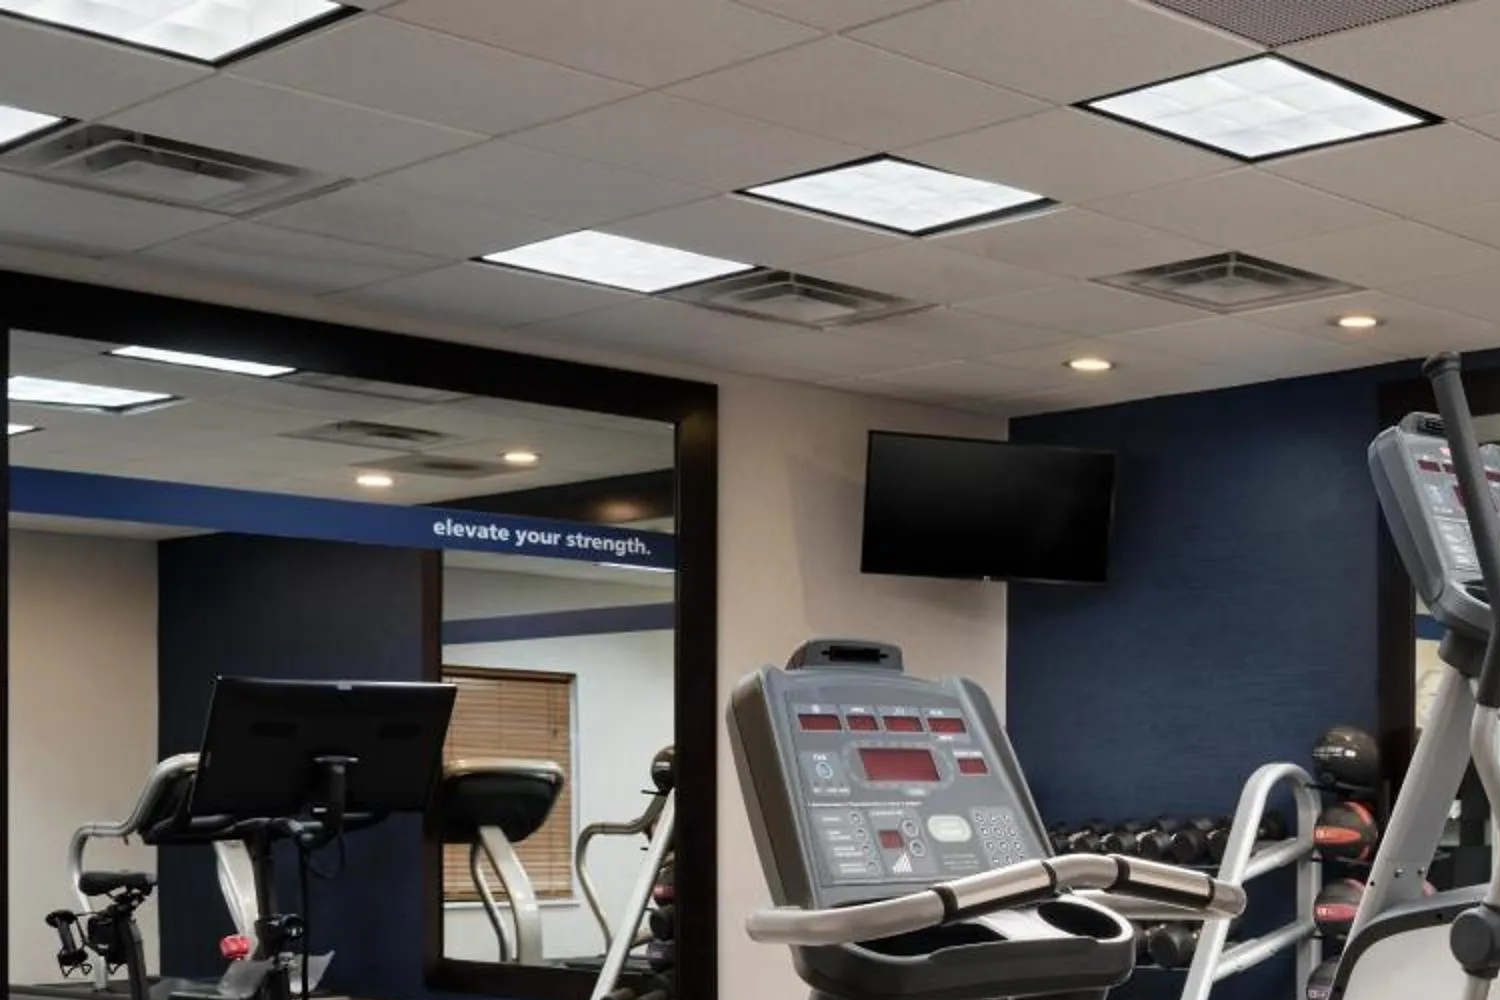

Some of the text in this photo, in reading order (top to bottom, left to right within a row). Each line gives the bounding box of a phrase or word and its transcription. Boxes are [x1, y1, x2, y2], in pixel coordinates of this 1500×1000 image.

[433, 518, 651, 557] elevate your strength.
